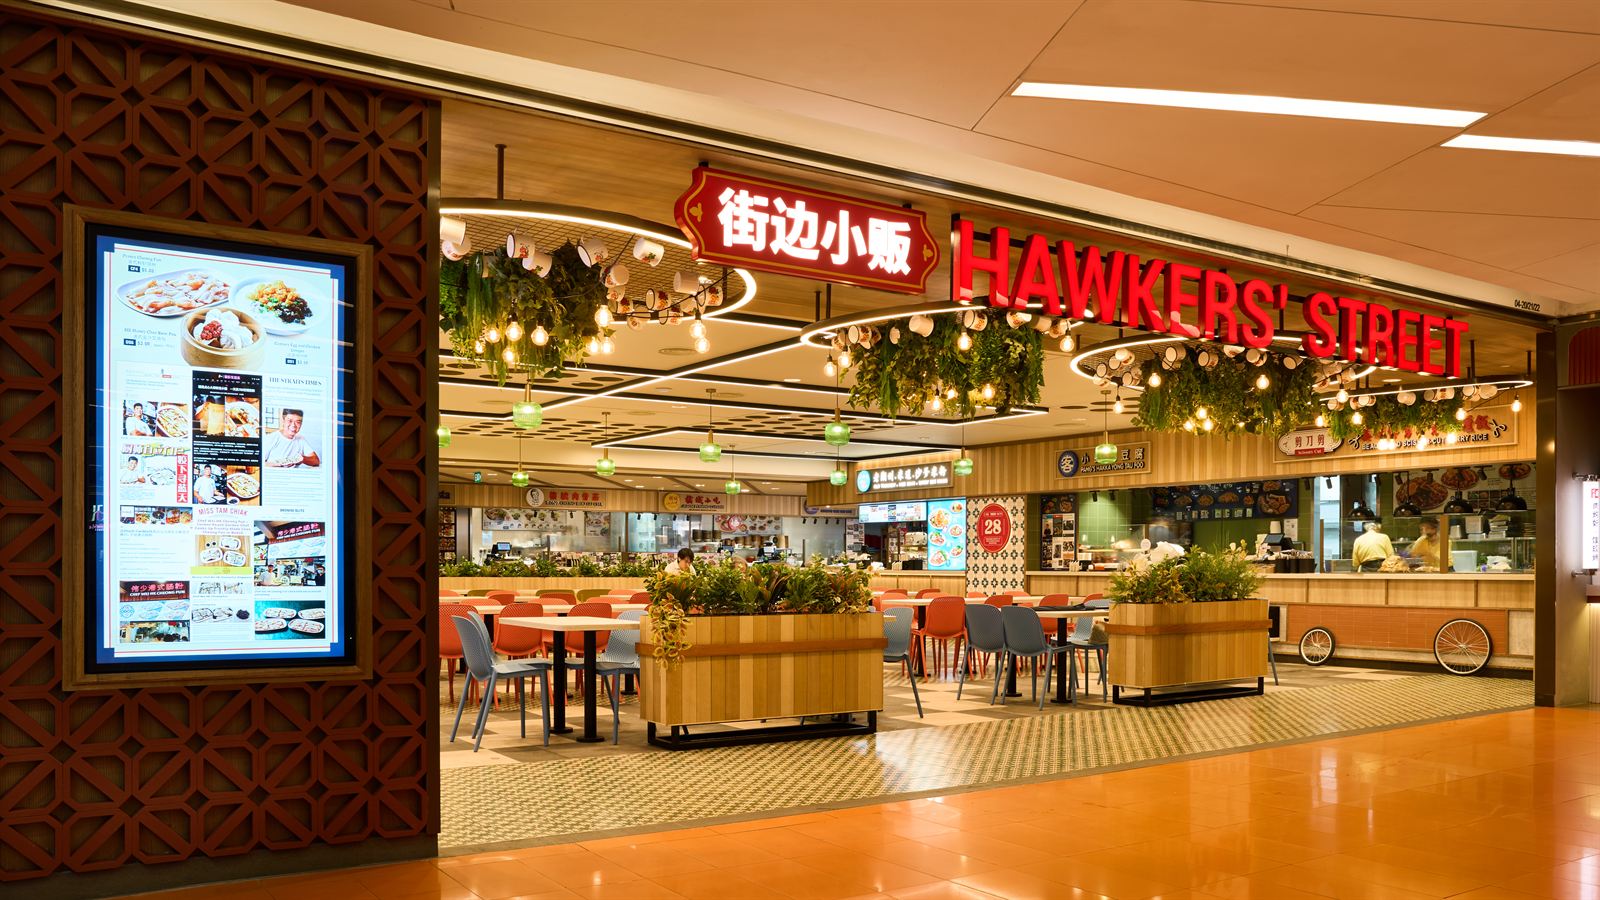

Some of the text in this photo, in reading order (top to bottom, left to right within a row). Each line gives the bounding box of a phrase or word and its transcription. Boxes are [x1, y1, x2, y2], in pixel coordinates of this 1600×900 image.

[718, 187, 911, 275] 街边小贩
[951, 216, 1469, 379] HAWKERS' STREET
[1471, 433, 1489, 442] RICE
[198, 507, 214, 516] MISS
[230, 507, 248, 516] CHIAK
[985, 519, 1002, 534] 28
